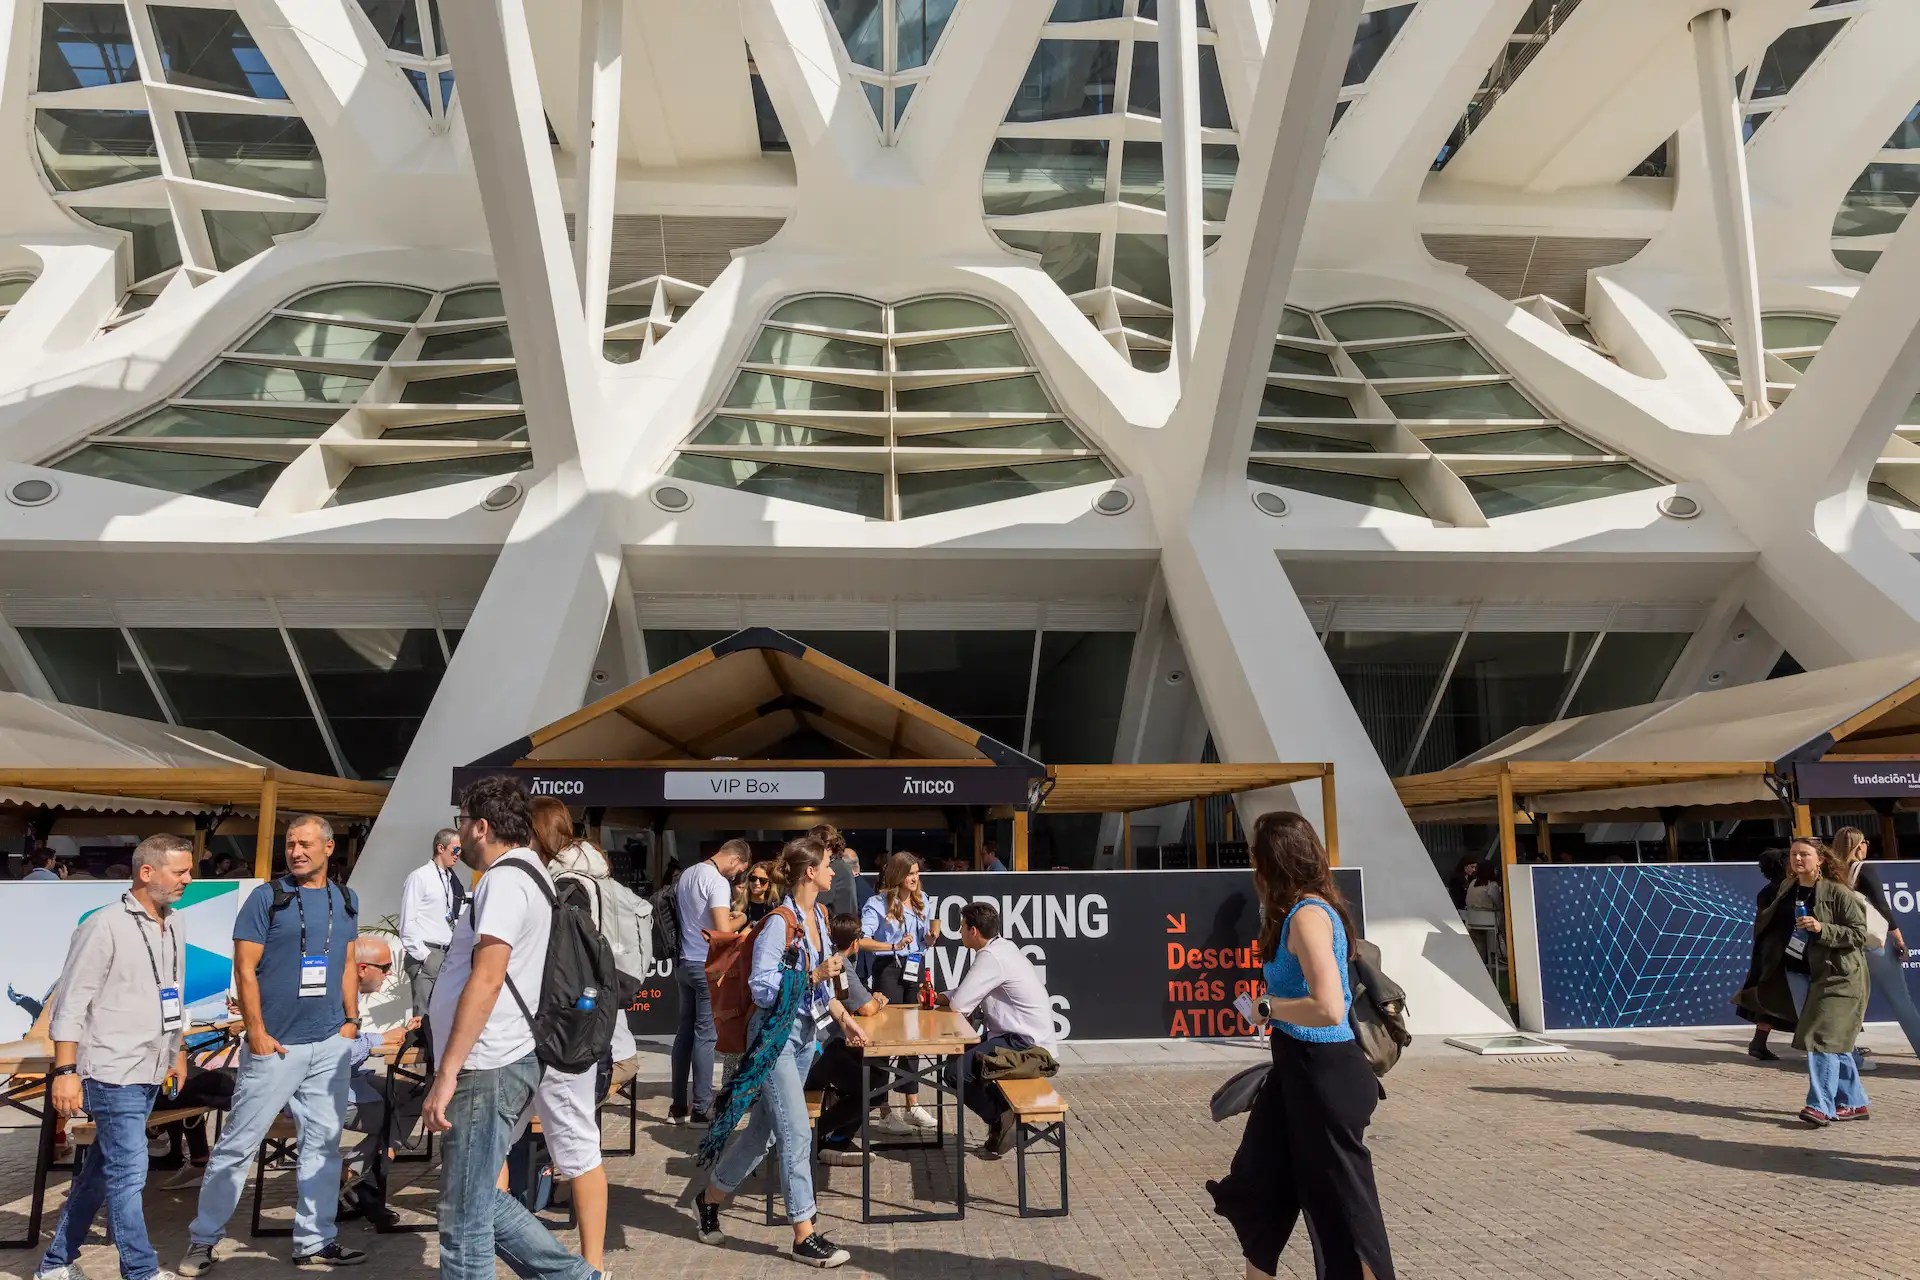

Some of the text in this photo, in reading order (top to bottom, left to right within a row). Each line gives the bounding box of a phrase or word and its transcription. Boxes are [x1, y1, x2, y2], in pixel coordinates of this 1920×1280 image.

[710, 778, 780, 793] VIP Box
[1168, 972, 1225, 1002] más
